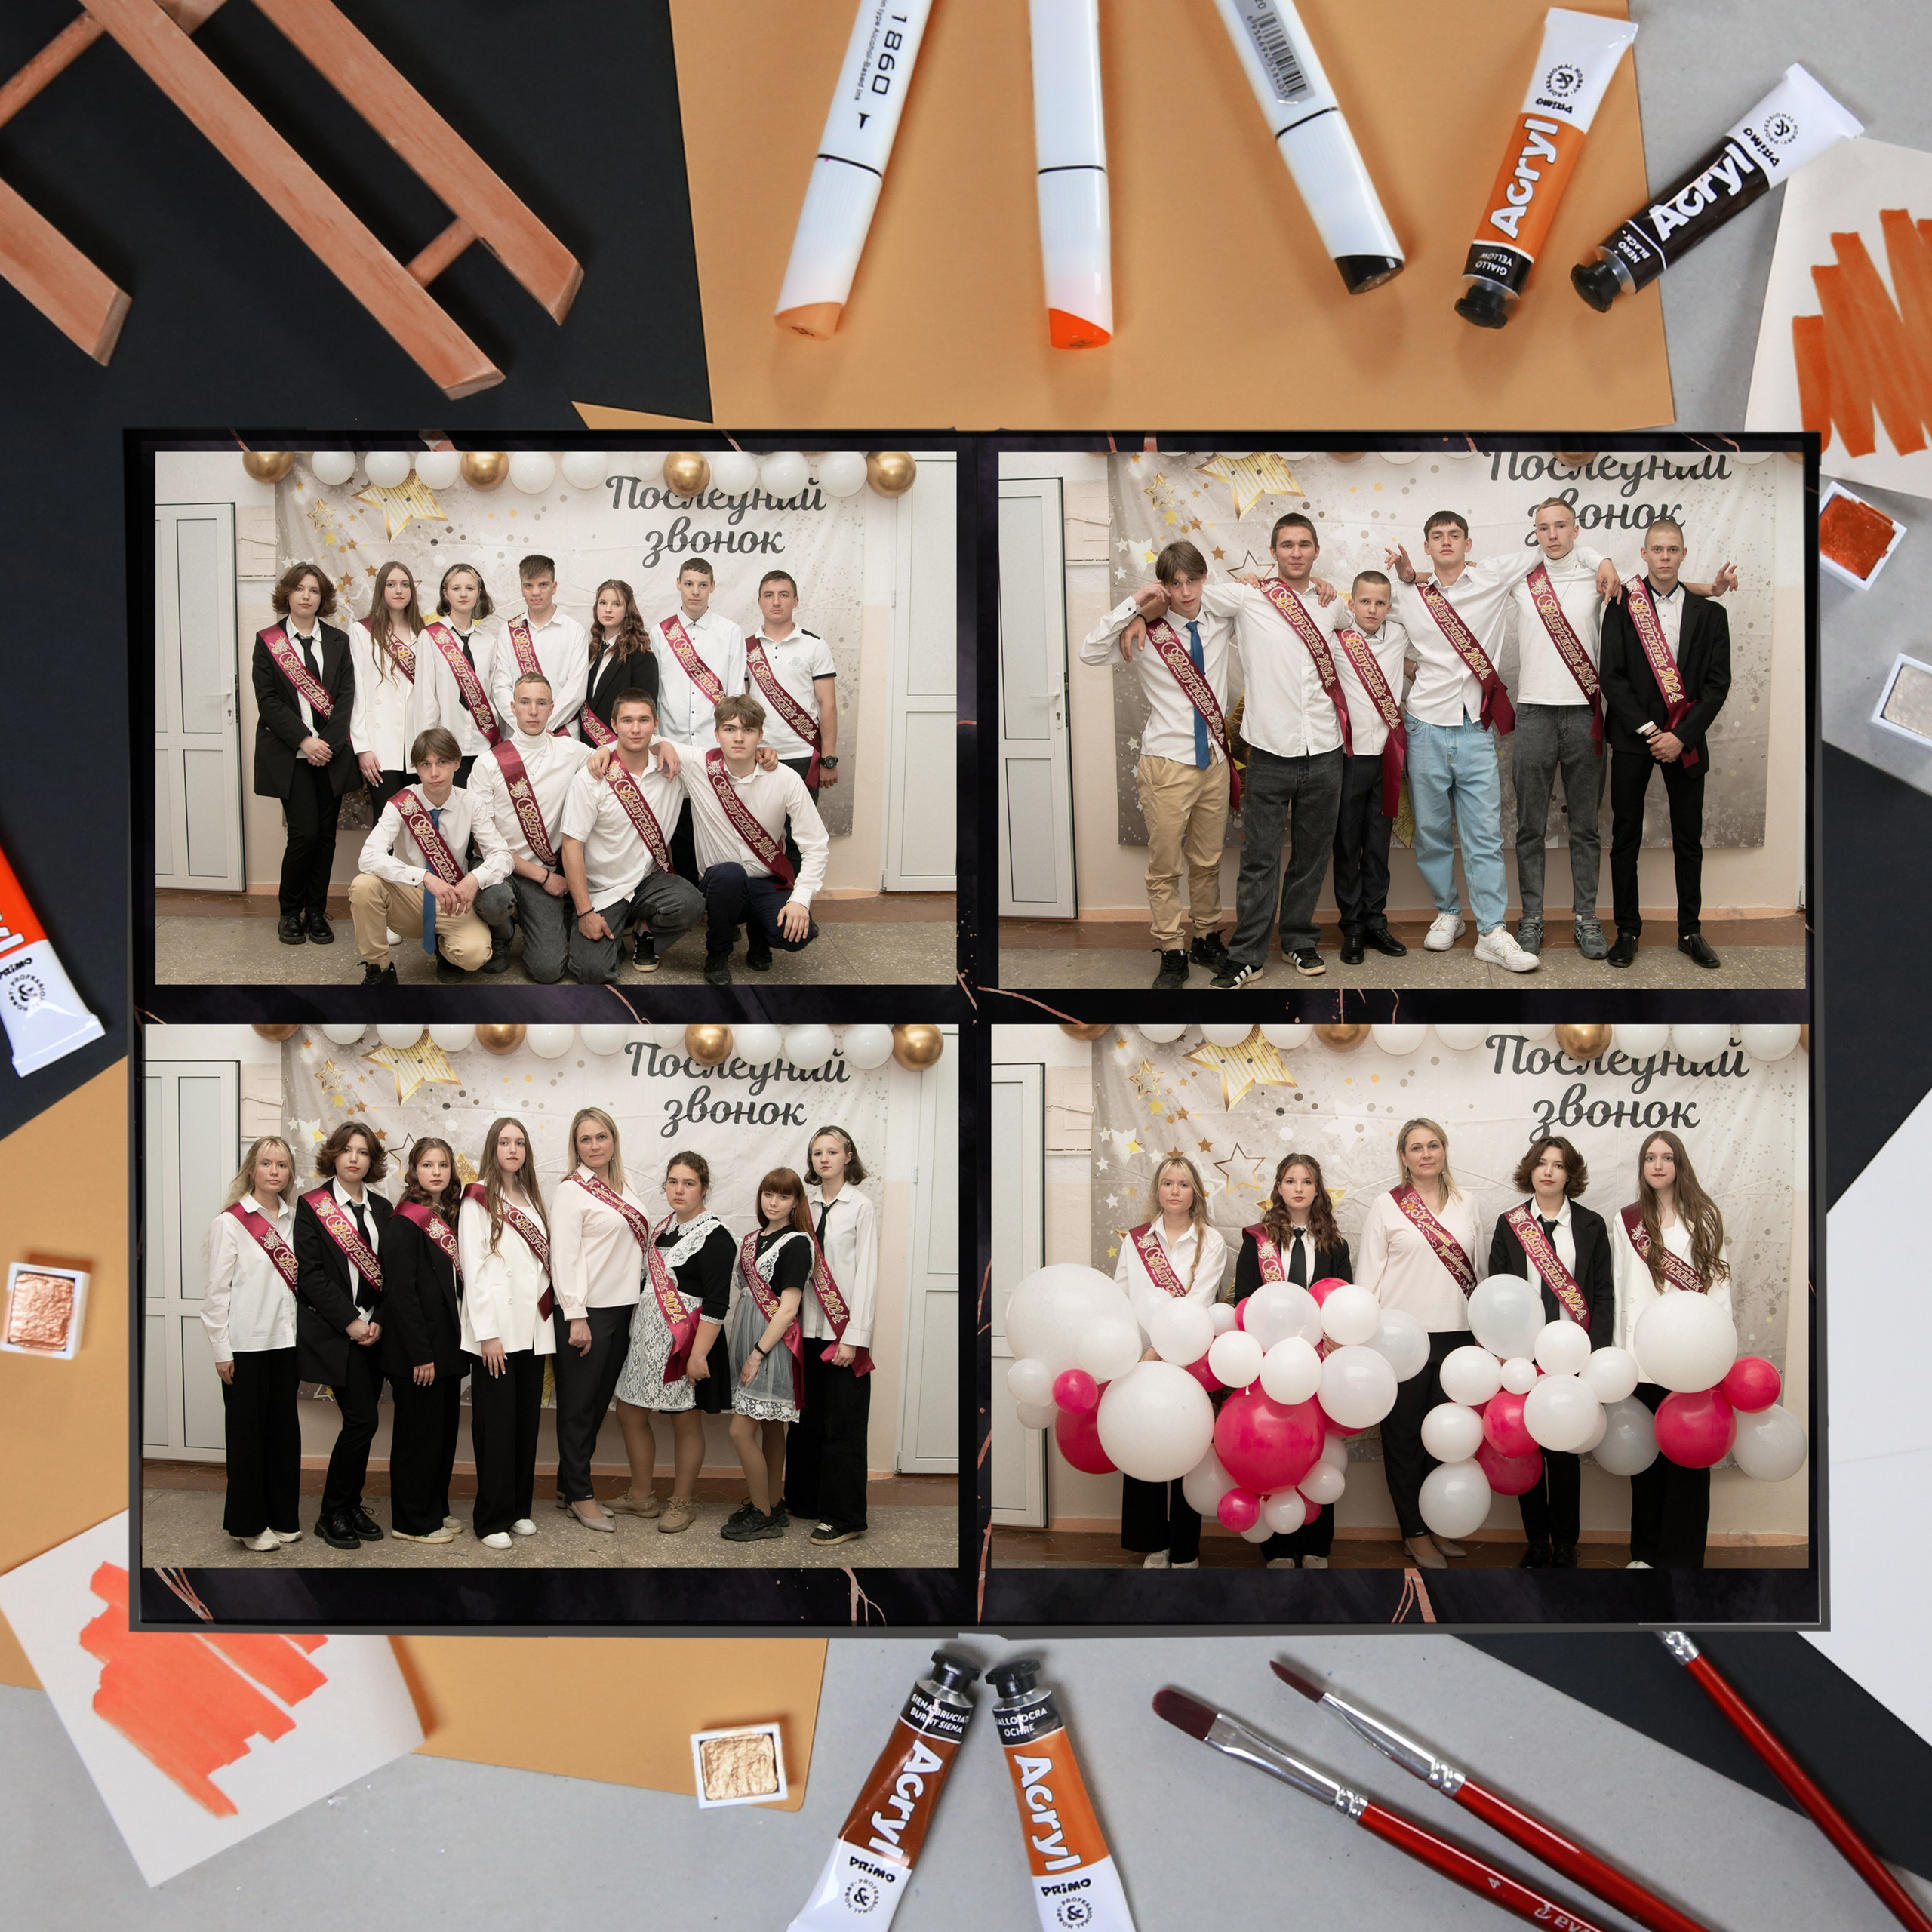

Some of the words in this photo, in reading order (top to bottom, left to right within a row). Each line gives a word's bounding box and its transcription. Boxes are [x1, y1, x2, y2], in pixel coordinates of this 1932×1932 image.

[872, 15, 908, 95] 1860
[1489, 118, 1559, 240] Acryl
[1647, 143, 1755, 242] Acryl
[1475, 260, 1508, 276] GIALLO
[1479, 252, 1512, 267] YELLOW
[1617, 240, 1641, 264] NERO
[1623, 234, 1651, 259] BLACK
[641, 515, 786, 568] звонок
[512, 627, 535, 674] Выпуск
[1269, 586, 1324, 657] Выпускник
[1316, 653, 1337, 688] 2024
[1423, 586, 1472, 651] Выпускник
[1463, 647, 1492, 681] 2024
[1537, 594, 1583, 665] Выпускник
[1574, 661, 1600, 695] 2024
[1629, 591, 1668, 668] Выпускник
[1657, 668, 1684, 703] 2024
[278, 651, 330, 709] Выпускник
[442, 644, 481, 706] Выпускник
[472, 704, 494, 734] 2024
[673, 638, 719, 694] Выпускник
[1161, 641, 1215, 715] Выпускник
[1208, 710, 1226, 745] 2024
[1341, 629, 1386, 698] Выпускник
[1377, 695, 1401, 729] 2024
[752, 660, 798, 719] Выпускник
[791, 714, 817, 741] 2024
[583, 717, 611, 746] 2024
[614, 779, 660, 848] Выпускник
[652, 842, 670, 872] 2024
[712, 775, 762, 842] Выпускник
[752, 836, 780, 863] 2024
[408, 813, 457, 885] Выпускник
[660, 1085, 807, 1138] звонок
[1529, 1082, 1700, 1144] звонок
[325, 1214, 382, 1278] Выпускник
[617, 1206, 648, 1241] руководи
[1410, 1208, 1456, 1247] Классный
[742, 1241, 770, 1303] Выпускник
[762, 1300, 781, 1318] 20
[1144, 1247, 1180, 1298] Выпуск
[1435, 1245, 1476, 1284] руководи
[1516, 1221, 1567, 1289] Выпускник
[1558, 1285, 1587, 1321] 2024
[660, 1290, 688, 1324] 2024
[820, 1291, 848, 1324] 2024
[909, 1706, 940, 1727] BURNT
[937, 1721, 963, 1734] SIENA
[910, 1693, 934, 1713] SIENA
[996, 1715, 1018, 1727] ALLO
[1020, 1707, 1048, 1723] OCRA
[1004, 1723, 1035, 1737] OCHRE
[868, 1738, 943, 1860] Acryl
[1014, 1753, 1082, 1872] Acryl
[1487, 1876, 1502, 1889] 4
[1554, 1915, 1591, 1932] ev
